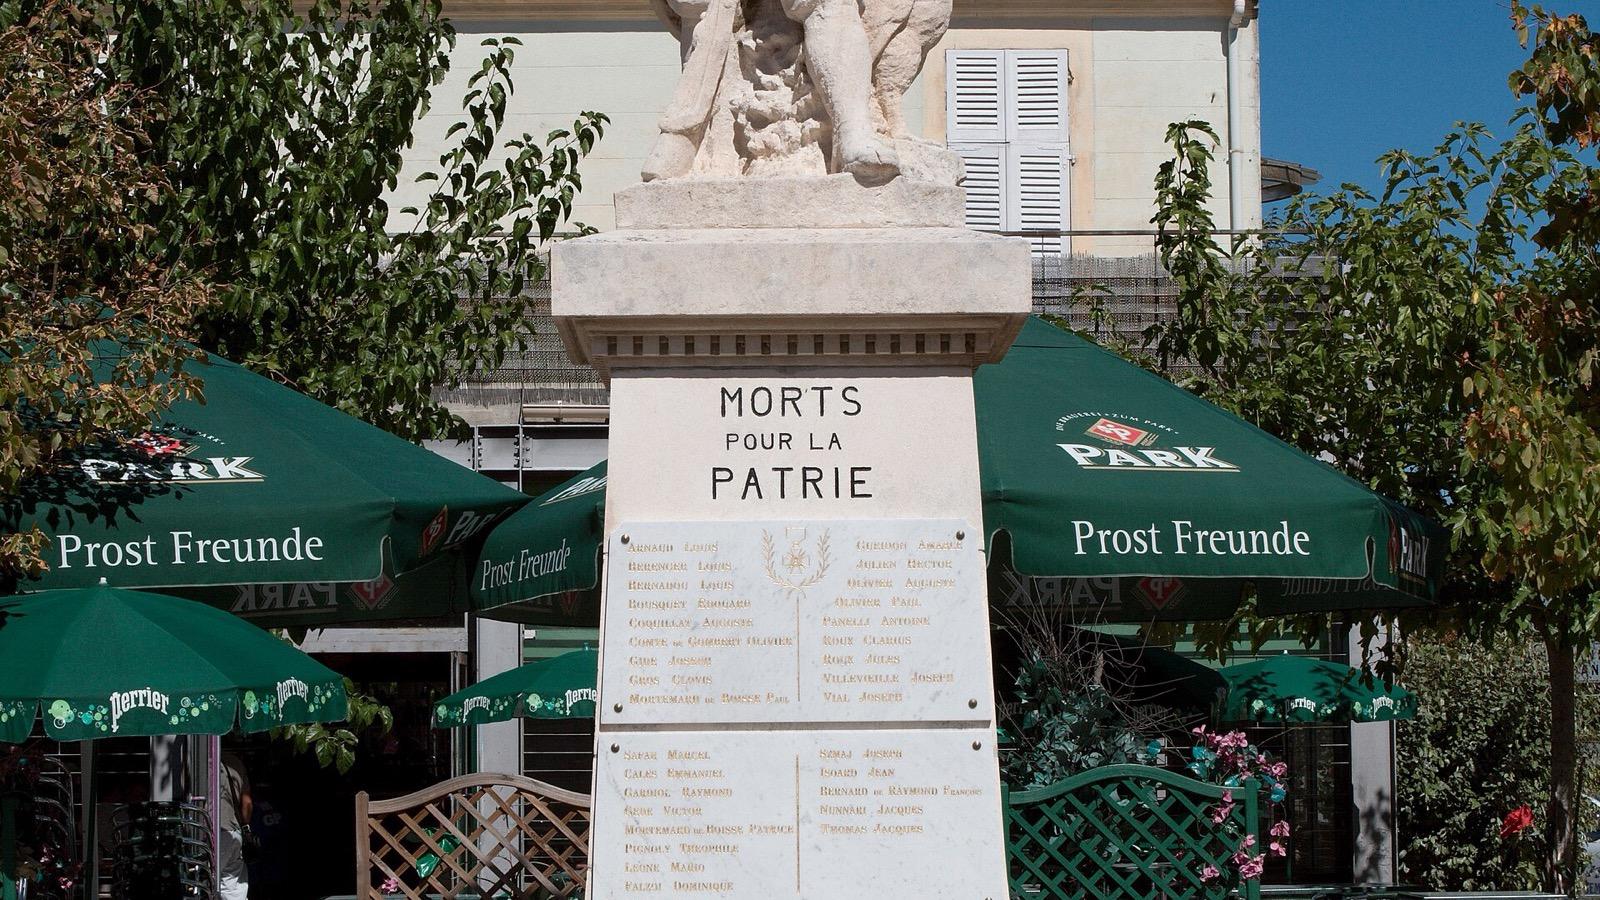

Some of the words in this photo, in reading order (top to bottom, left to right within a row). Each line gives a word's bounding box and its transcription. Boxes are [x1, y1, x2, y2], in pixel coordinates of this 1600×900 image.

[720, 386, 862, 417] MORTS
[726, 432, 793, 451] POUR
[809, 432, 842, 451] LA
[1056, 443, 1241, 470] PARK
[711, 466, 873, 500] PATRIE
[56, 533, 158, 569] Prost
[170, 527, 323, 564] Freunde
[1071, 520, 1162, 555] Prost
[1171, 521, 1310, 556] Freunde
[480, 555, 516, 591] Prost
[517, 538, 571, 582] Freunde
[564, 687, 598, 715] perrie
